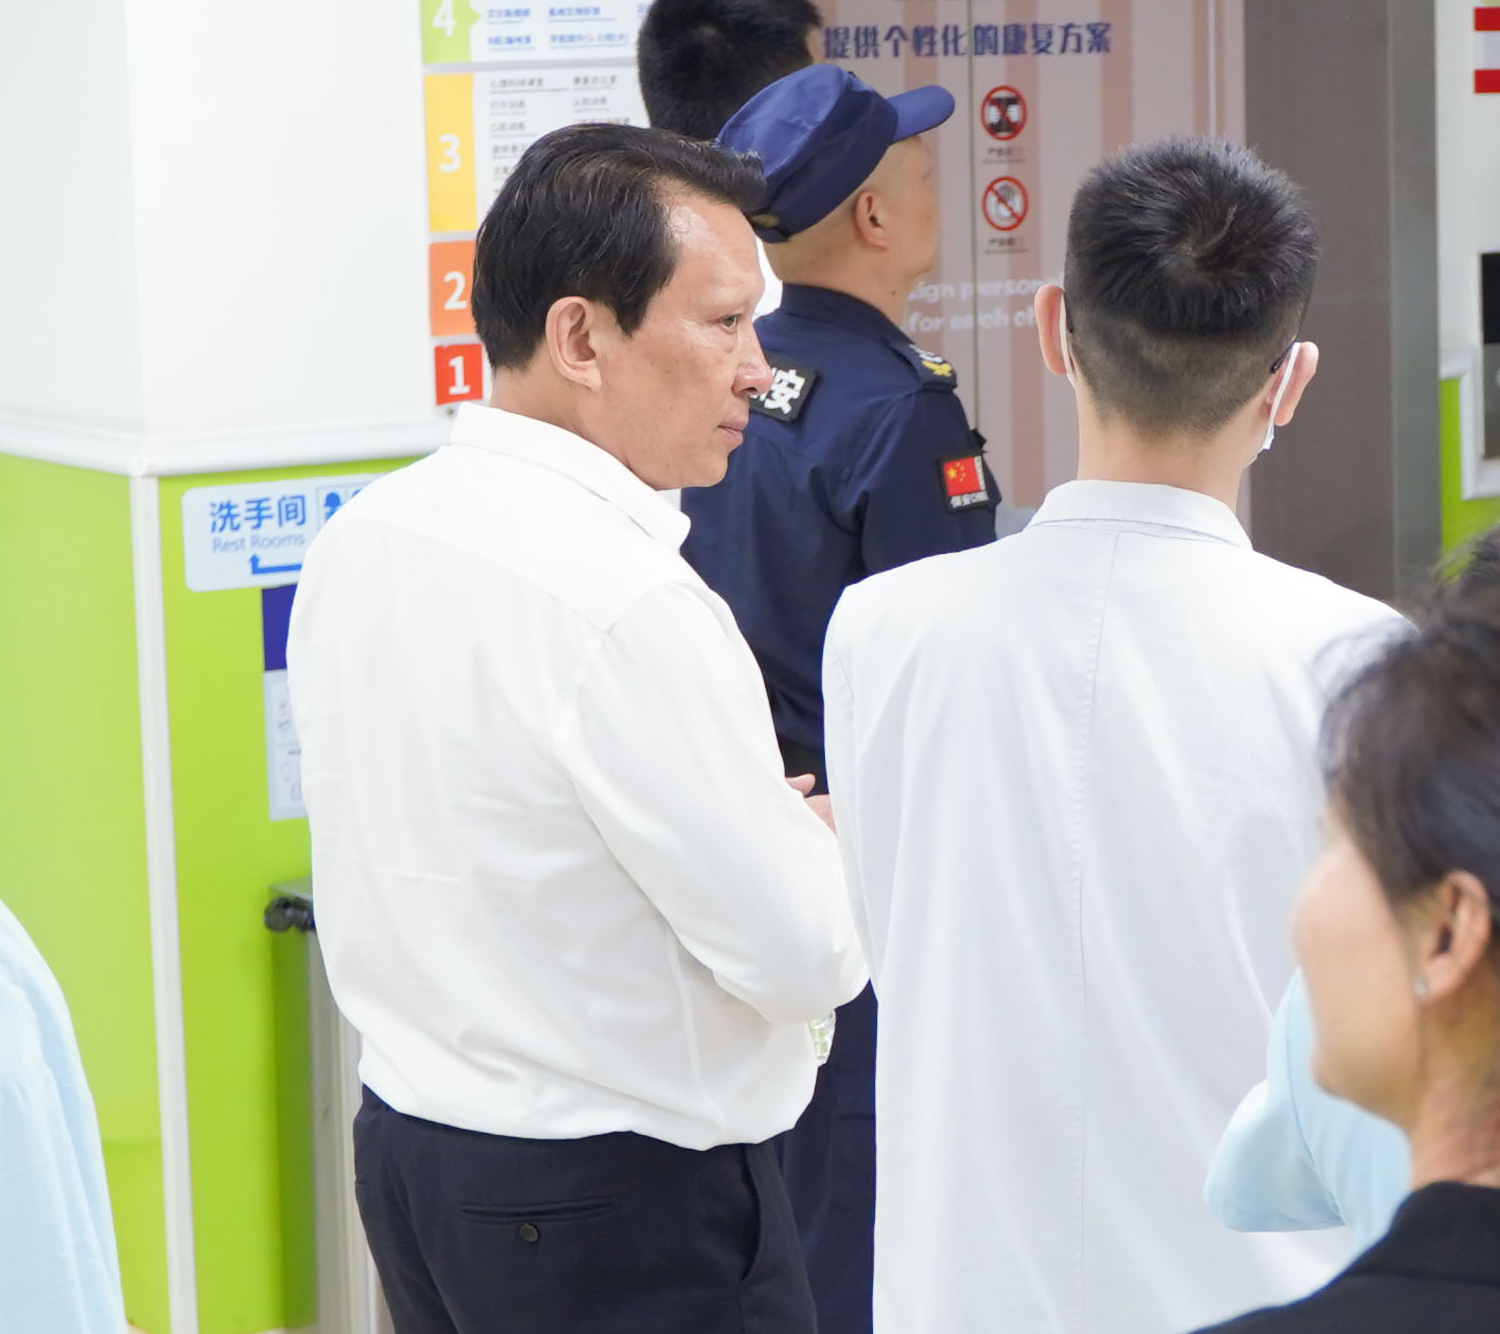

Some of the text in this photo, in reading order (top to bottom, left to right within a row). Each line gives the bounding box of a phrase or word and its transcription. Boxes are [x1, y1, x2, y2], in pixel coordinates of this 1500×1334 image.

[823, 21, 1113, 60] 提供个性化的康复方案
[437, 133, 462, 174] 3
[443, 270, 467, 311] 2
[447, 355, 471, 395] 1
[750, 366, 806, 415] 安
[209, 494, 307, 535] 洗手间
[212, 532, 306, 554] Rest Rooms
